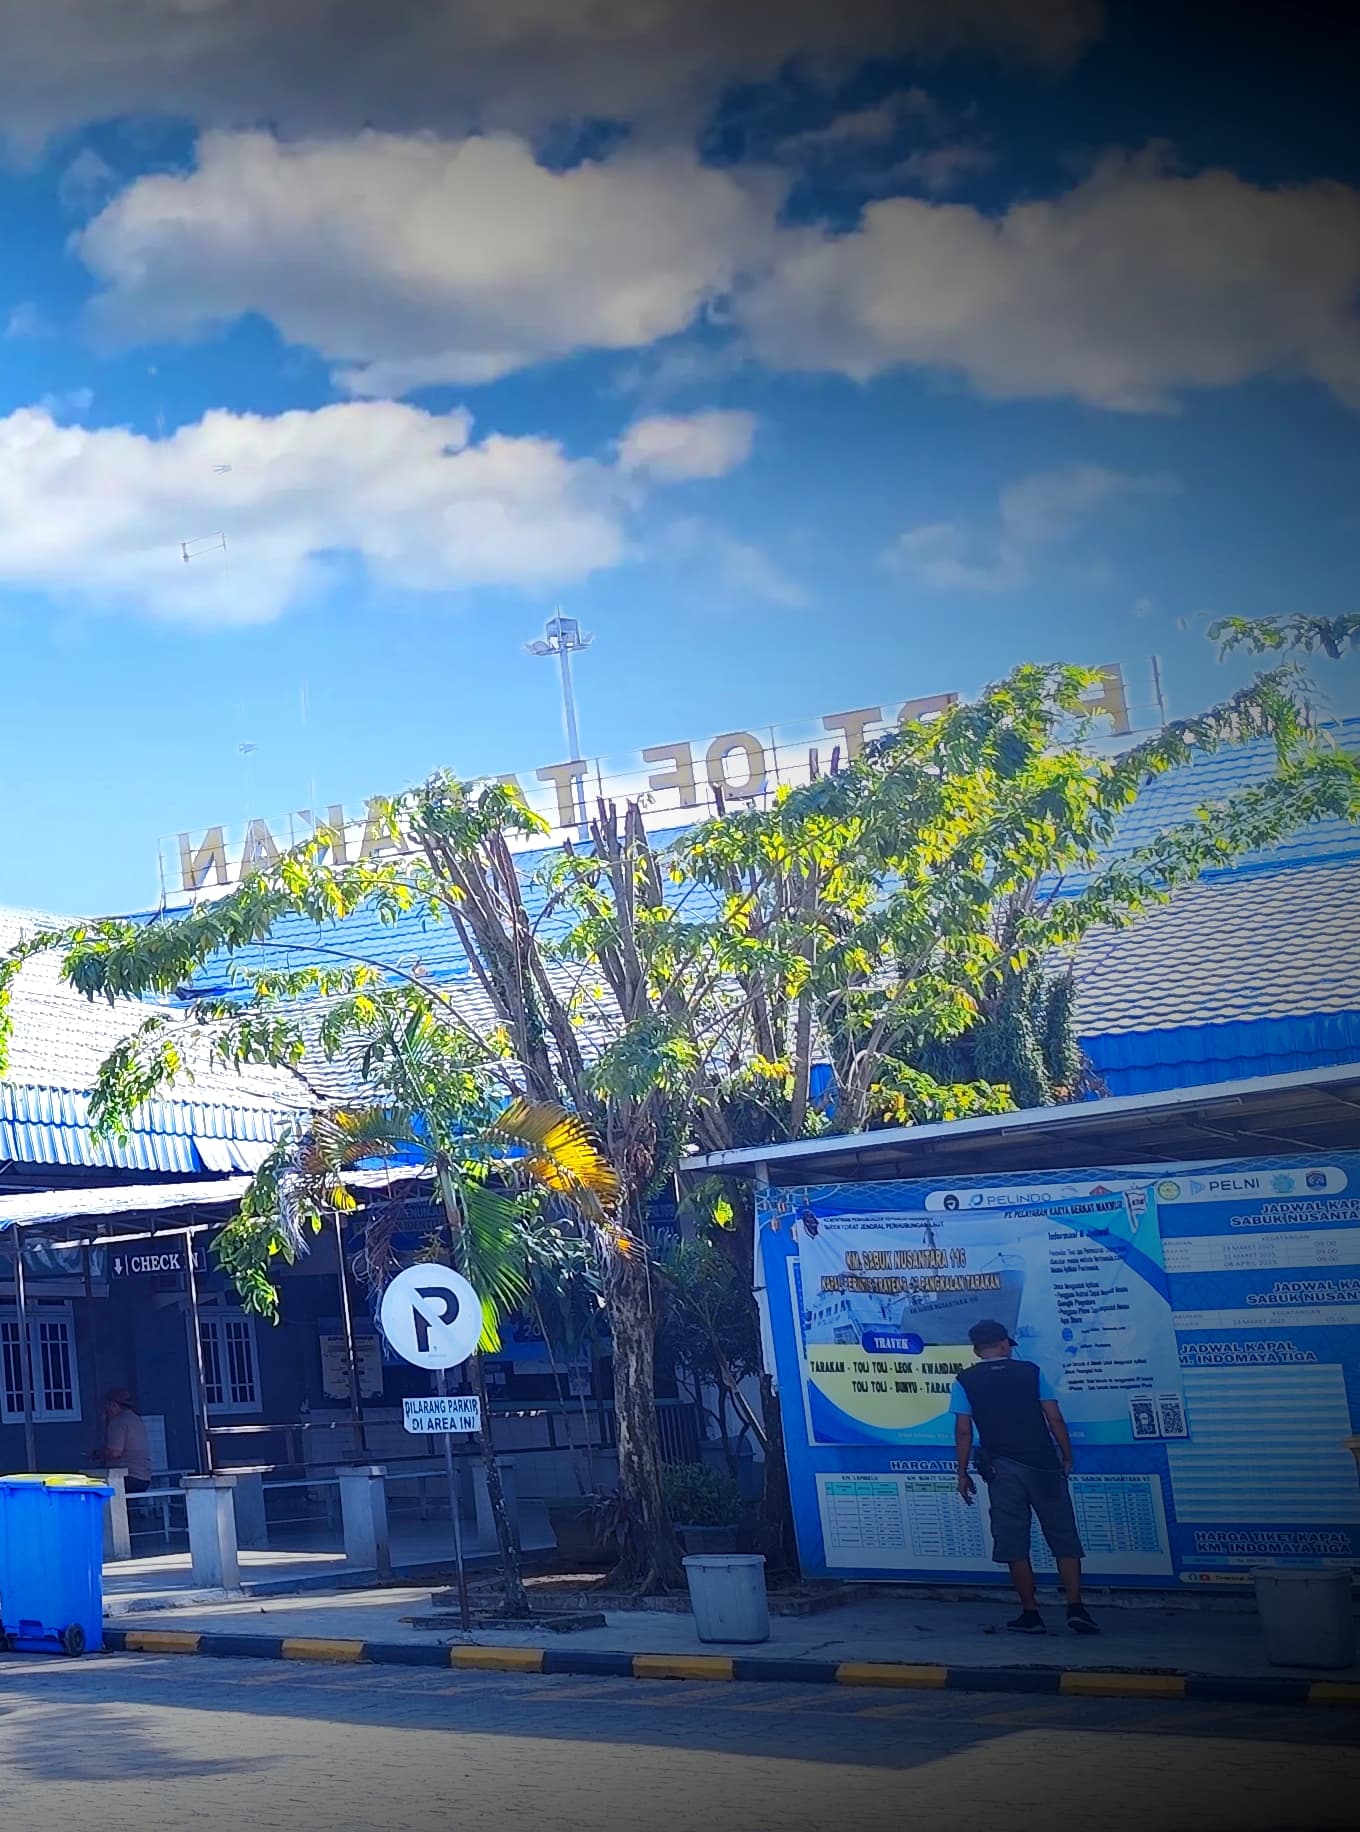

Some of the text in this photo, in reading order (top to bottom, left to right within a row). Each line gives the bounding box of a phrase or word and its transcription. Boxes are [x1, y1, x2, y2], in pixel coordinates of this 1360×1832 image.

[1209, 1177, 1260, 1192] PELNI
[987, 1193, 1051, 1206] PELINDO
[1263, 1199, 1360, 1214] JADWAL KAP
[1231, 1210, 1360, 1226] SABUK NUSANTA
[130, 1253, 182, 1273] CHECK
[863, 1250, 893, 1271] SABUK
[894, 1249, 949, 1270] NUSANTARA
[965, 1272, 1001, 1291] TARAKAN
[1273, 1281, 1337, 1294] JADWAL
[1247, 1290, 1360, 1306] SABUK NUSAN
[873, 1336, 909, 1350] TRAYEK
[1181, 1340, 1297, 1354] JADWAL KAPAL
[1196, 1352, 1278, 1365] INDOMAYA
[1278, 1350, 1318, 1362] TIGA
[810, 1361, 845, 1373] TARAKAN
[894, 1361, 913, 1374] LEOK
[926, 1381, 952, 1394] TARAK
[405, 1398, 478, 1417] DILARANG PARKIR
[412, 1417, 475, 1431] DI AREA INI
[890, 1460, 940, 1472] HARGA
[1194, 1530, 1352, 1543] HARGA TIKET KAPAL
[1195, 1542, 1353, 1554] KM. INDOMAYA TIGA
